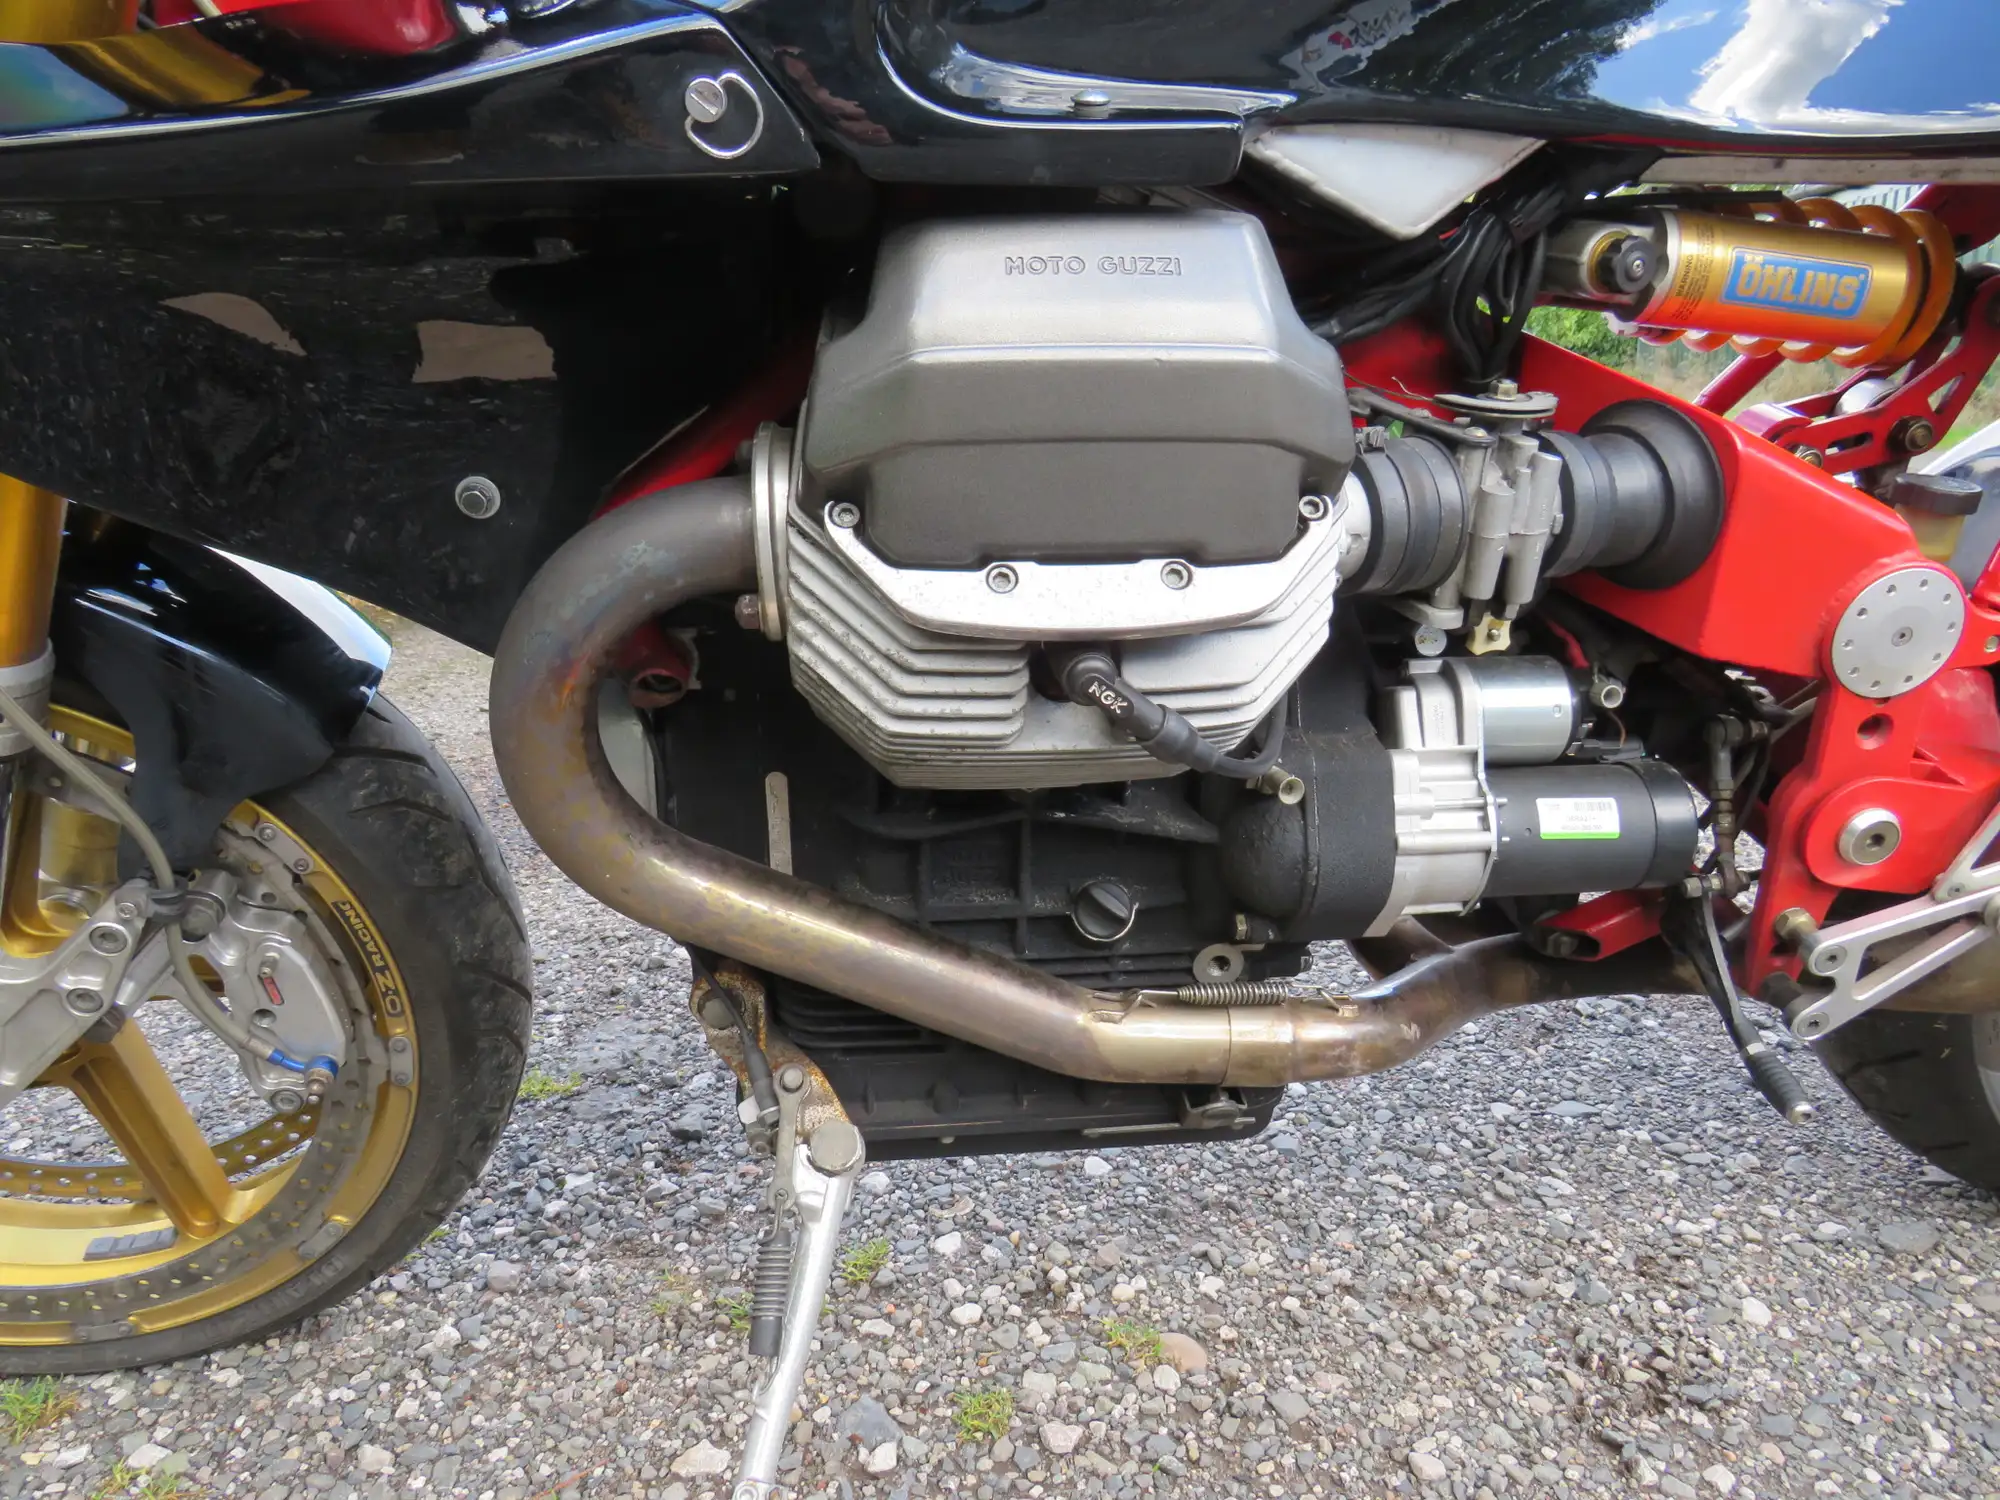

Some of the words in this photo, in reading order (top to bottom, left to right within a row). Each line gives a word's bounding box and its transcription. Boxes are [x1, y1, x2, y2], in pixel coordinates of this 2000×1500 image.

[1004, 256, 1086, 275] MOTO
[1097, 256, 1182, 275] GUZZI
[1675, 253, 1694, 298] WARNING
[1737, 253, 1861, 310] ÖHLINS
[1088, 681, 1128, 714] NGK
[338, 900, 386, 967] RACING
